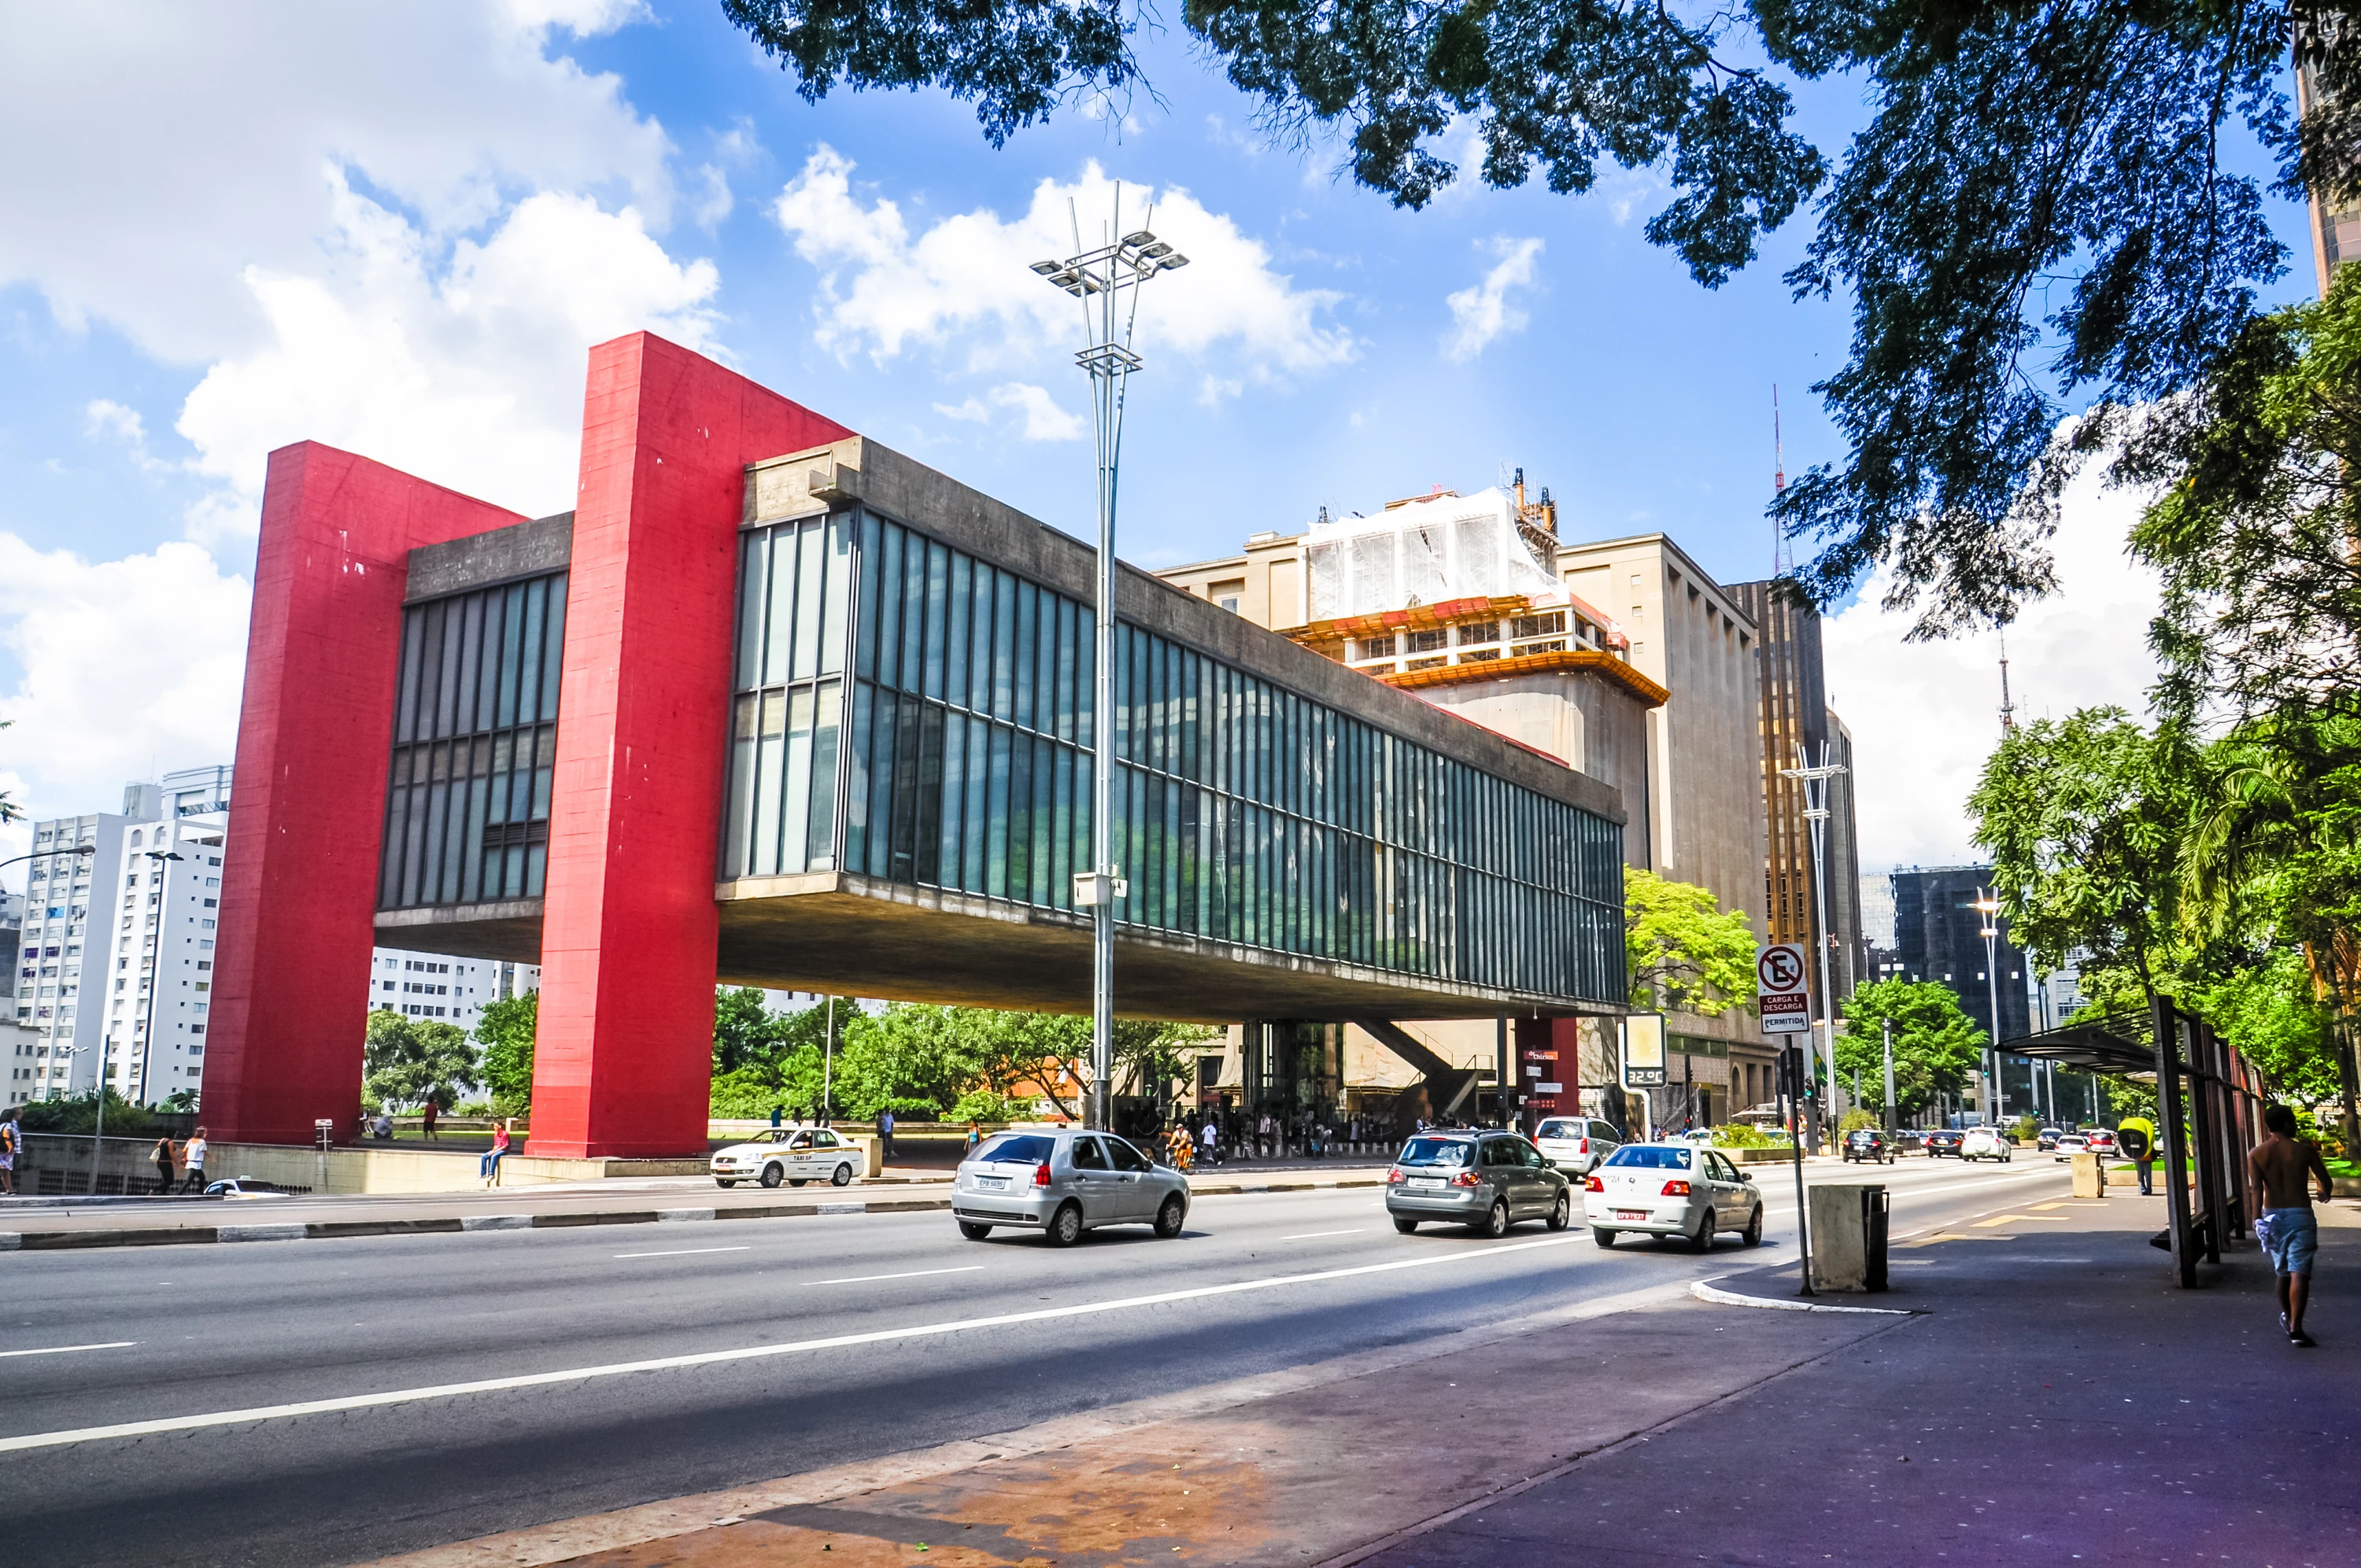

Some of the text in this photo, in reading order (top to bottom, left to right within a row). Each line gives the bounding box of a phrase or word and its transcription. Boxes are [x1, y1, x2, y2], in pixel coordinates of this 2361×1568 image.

[1772, 954, 1789, 983] E
[1764, 1003, 1803, 1012] DESCARGA
[1764, 1017, 1805, 1027] PERMITIDA
